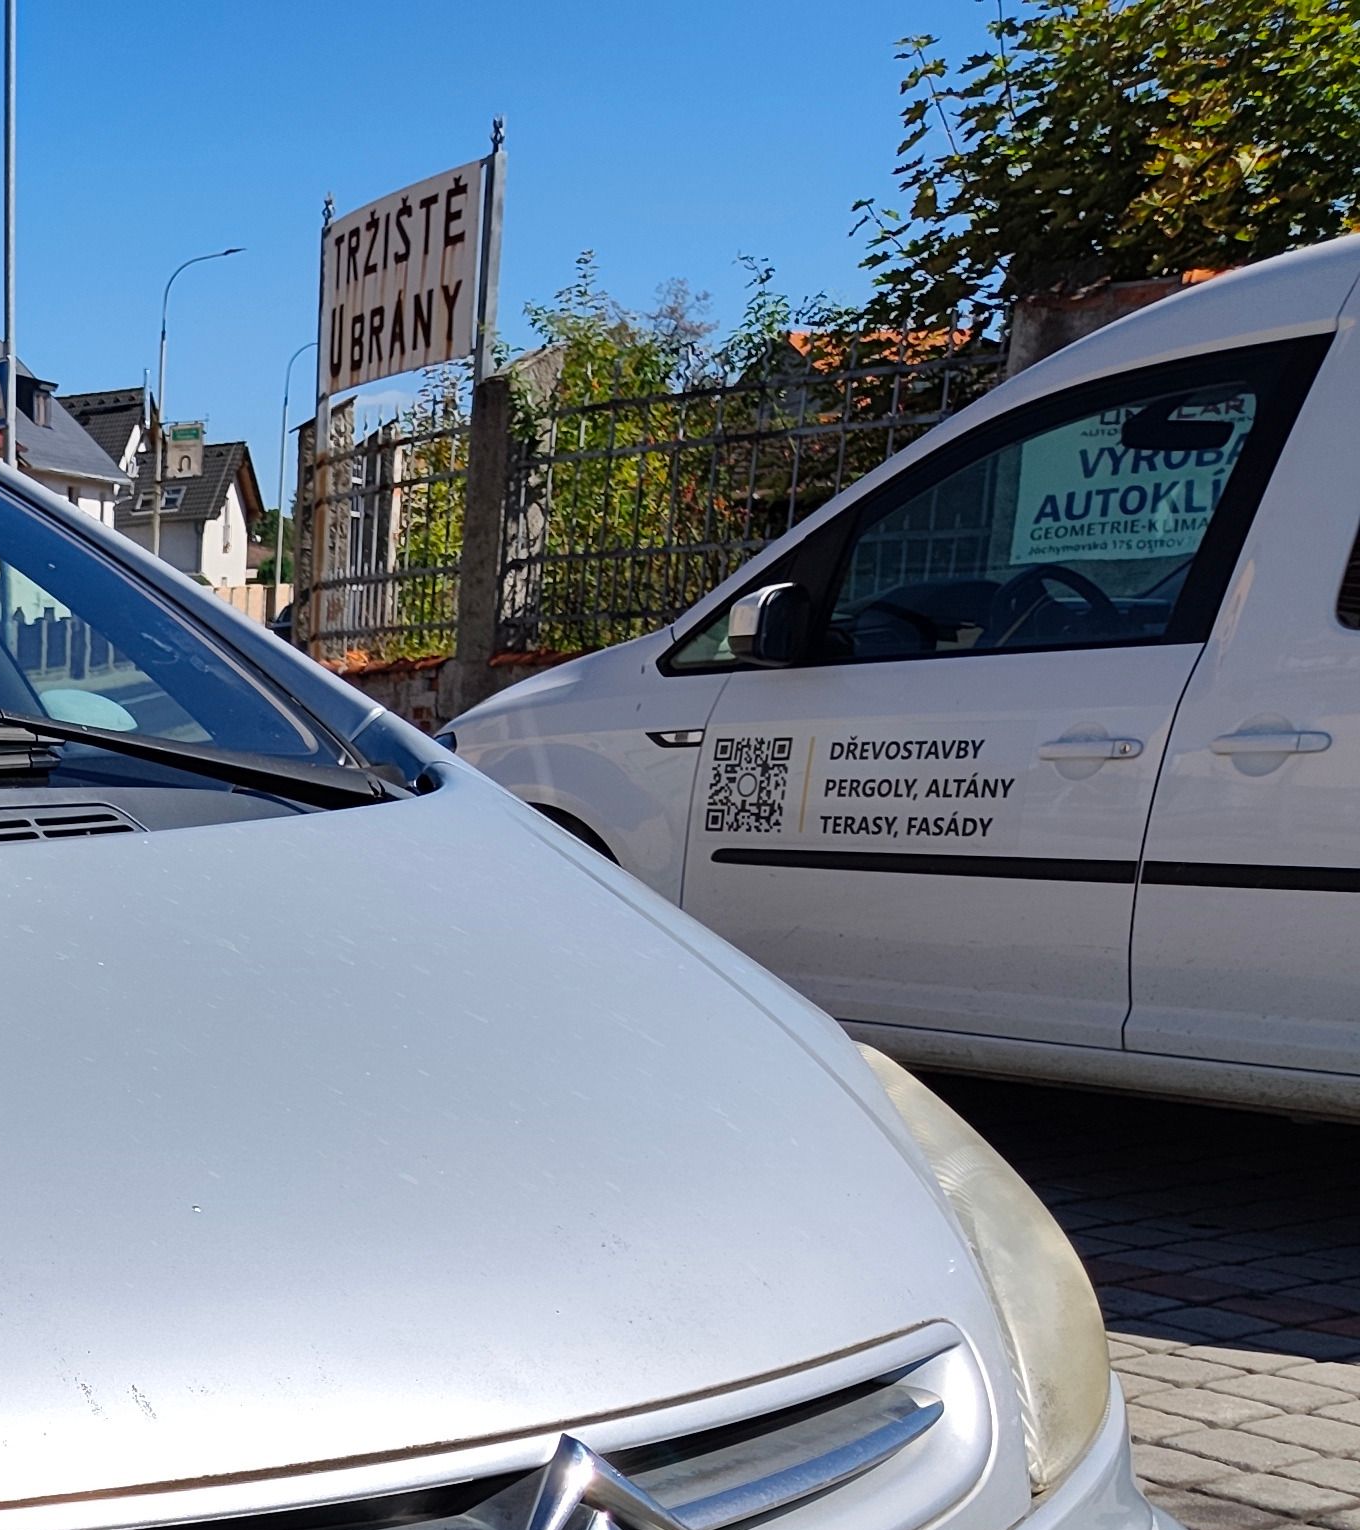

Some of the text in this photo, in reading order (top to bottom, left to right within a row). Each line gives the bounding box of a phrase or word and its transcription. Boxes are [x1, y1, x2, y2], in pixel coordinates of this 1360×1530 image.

[334, 175, 469, 290] TRŽIŠTĚ
[830, 736, 986, 760] DŘEVOSTAVBY
[824, 773, 1016, 801] PERGOLY, ALTÁNY
[820, 811, 994, 838] TERASY, FASÁDY
